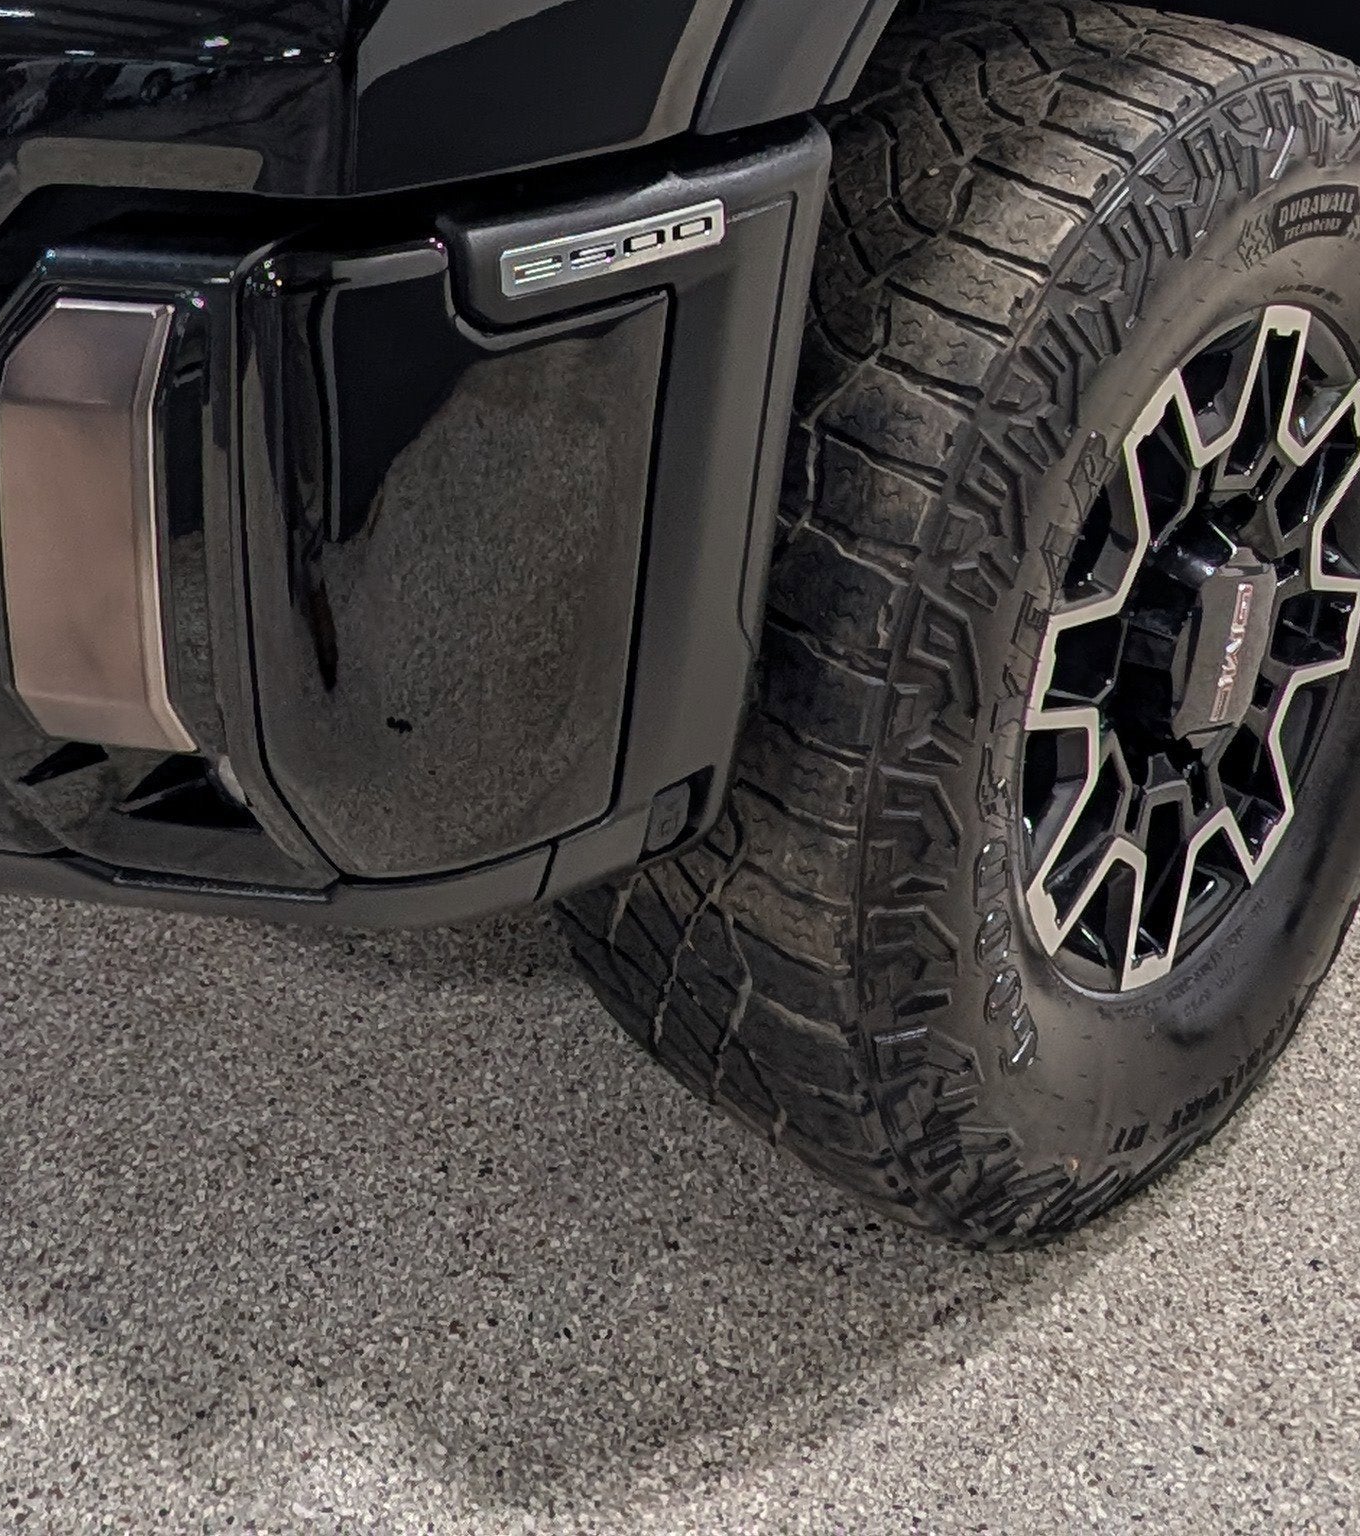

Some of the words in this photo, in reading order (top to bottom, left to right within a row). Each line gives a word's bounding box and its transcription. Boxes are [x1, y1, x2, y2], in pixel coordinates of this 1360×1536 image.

[1279, 192, 1355, 228] DURAWALL
[513, 216, 713, 285] 2500
[1209, 583, 1254, 722] GMC
